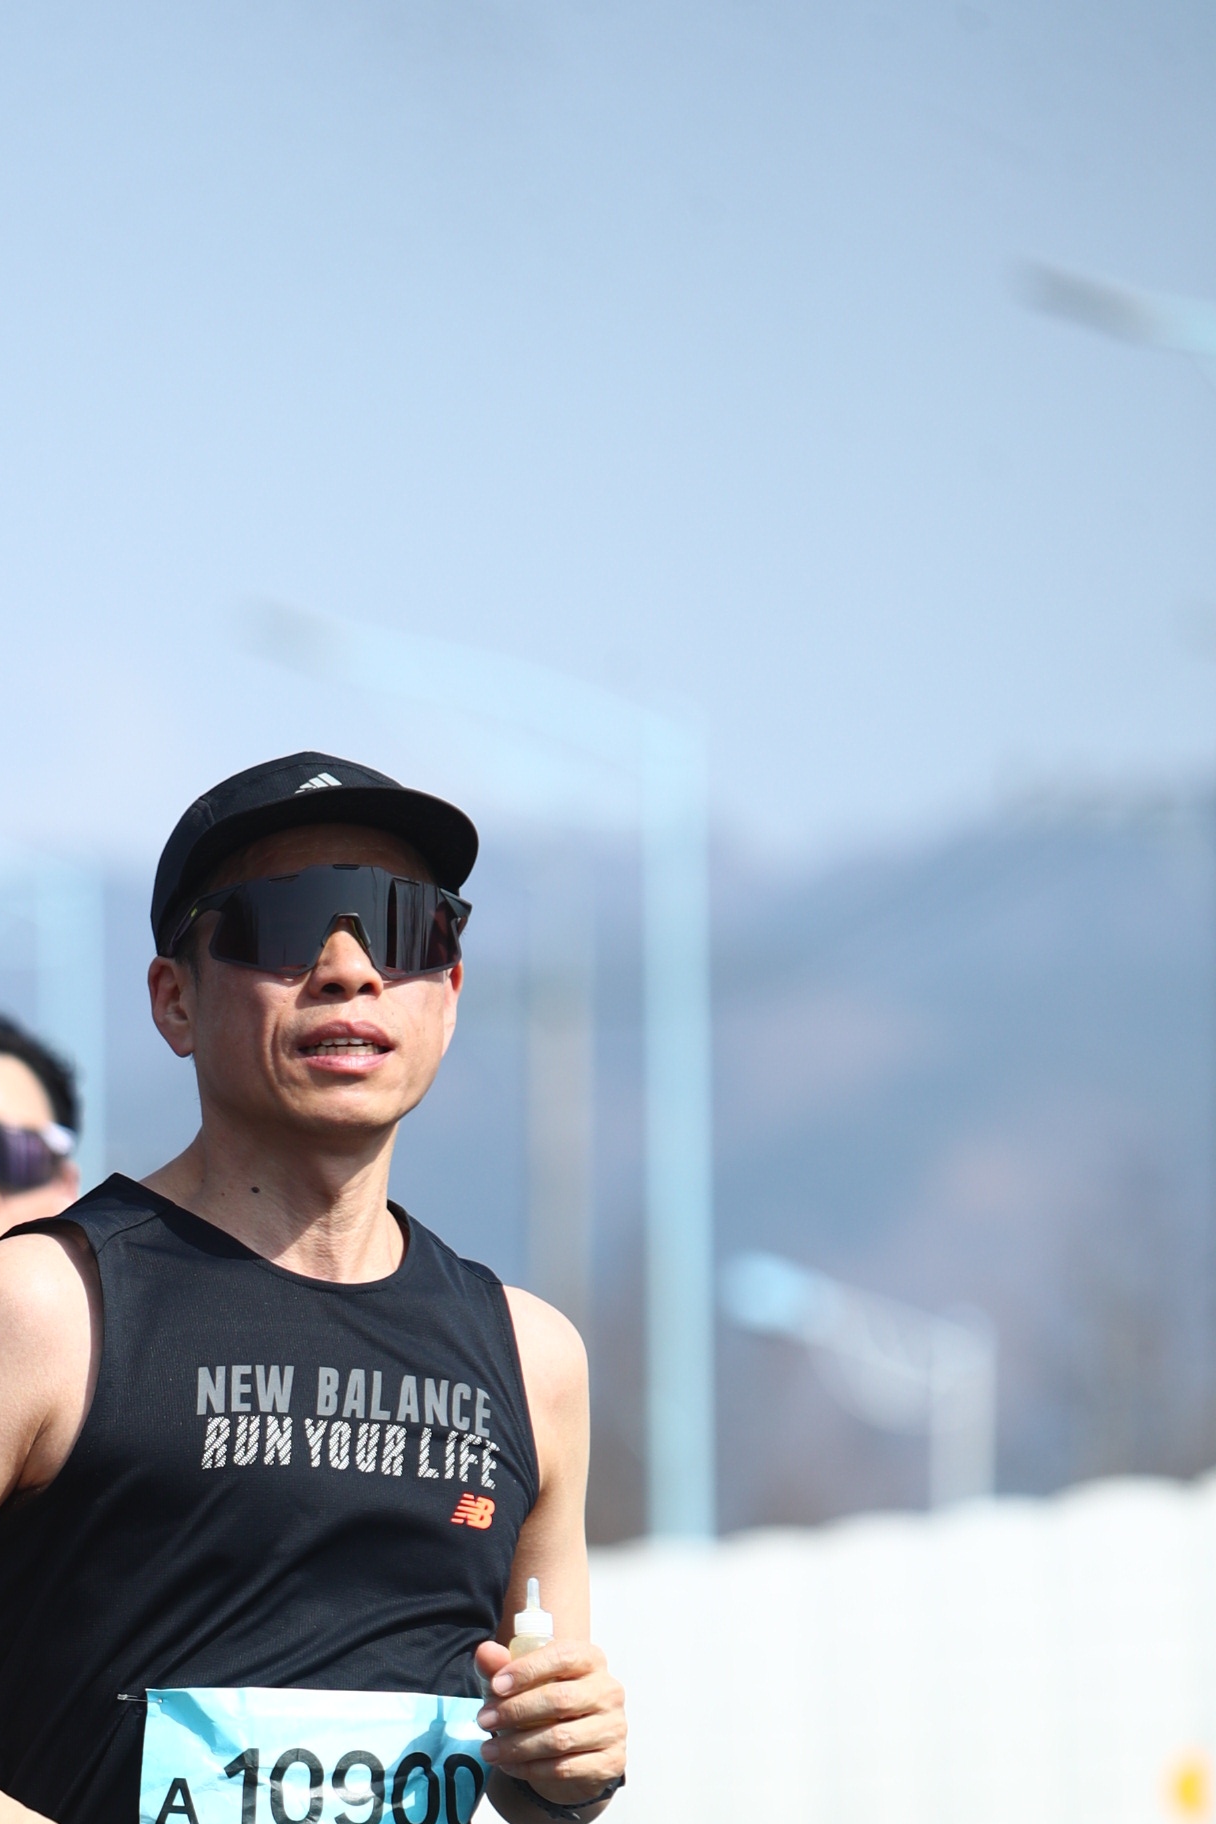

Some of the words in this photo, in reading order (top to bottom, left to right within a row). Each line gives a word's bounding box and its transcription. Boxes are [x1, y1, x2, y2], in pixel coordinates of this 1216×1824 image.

[196, 1365, 295, 1415] NEW
[316, 1367, 491, 1438] BALANCE
[201, 1415, 293, 1469] RUN
[304, 1418, 406, 1476] YOUR
[417, 1427, 500, 1489] LIFE
